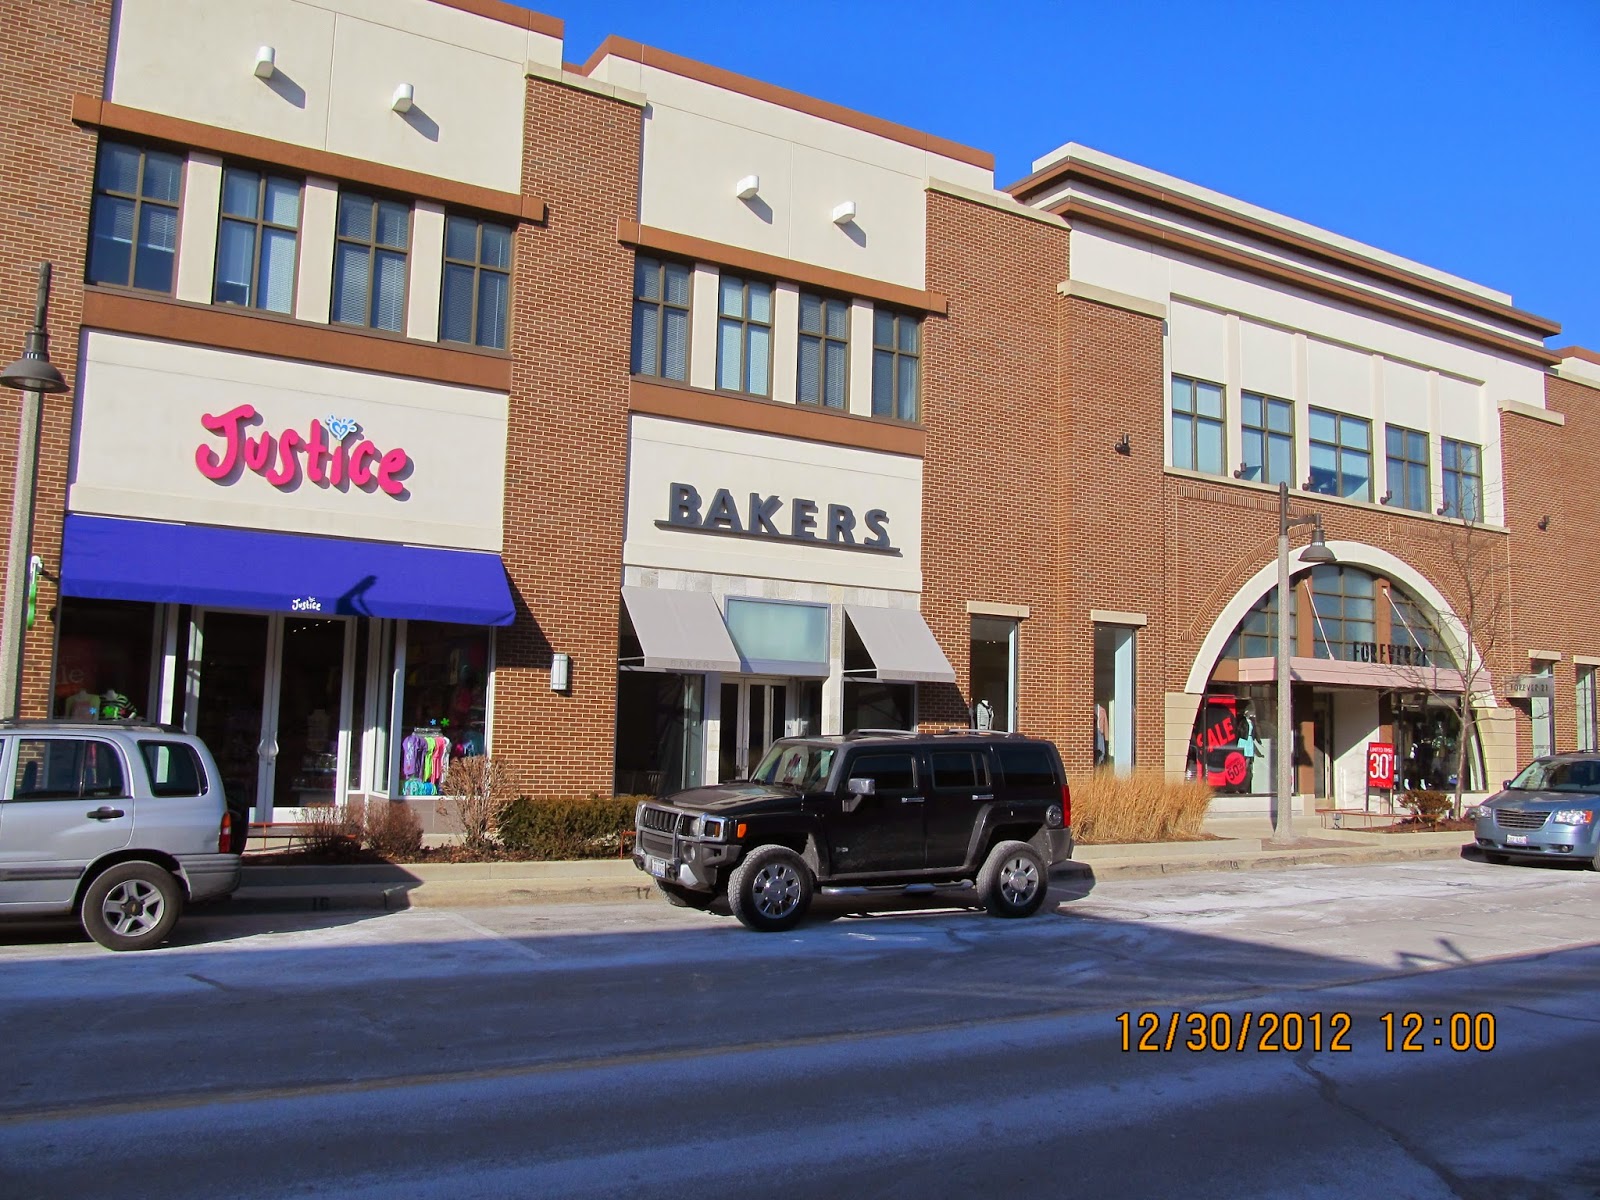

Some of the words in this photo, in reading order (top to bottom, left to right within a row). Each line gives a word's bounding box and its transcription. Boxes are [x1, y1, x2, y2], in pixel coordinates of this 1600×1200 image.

[195, 404, 408, 495] Justice
[669, 482, 891, 548] BAKERS
[291, 597, 321, 611] Justice
[671, 659, 717, 669] BAKERS
[1353, 641, 1410, 665] FOREVER
[1510, 683, 1539, 691] FOREVER
[1196, 717, 1236, 754] SALE
